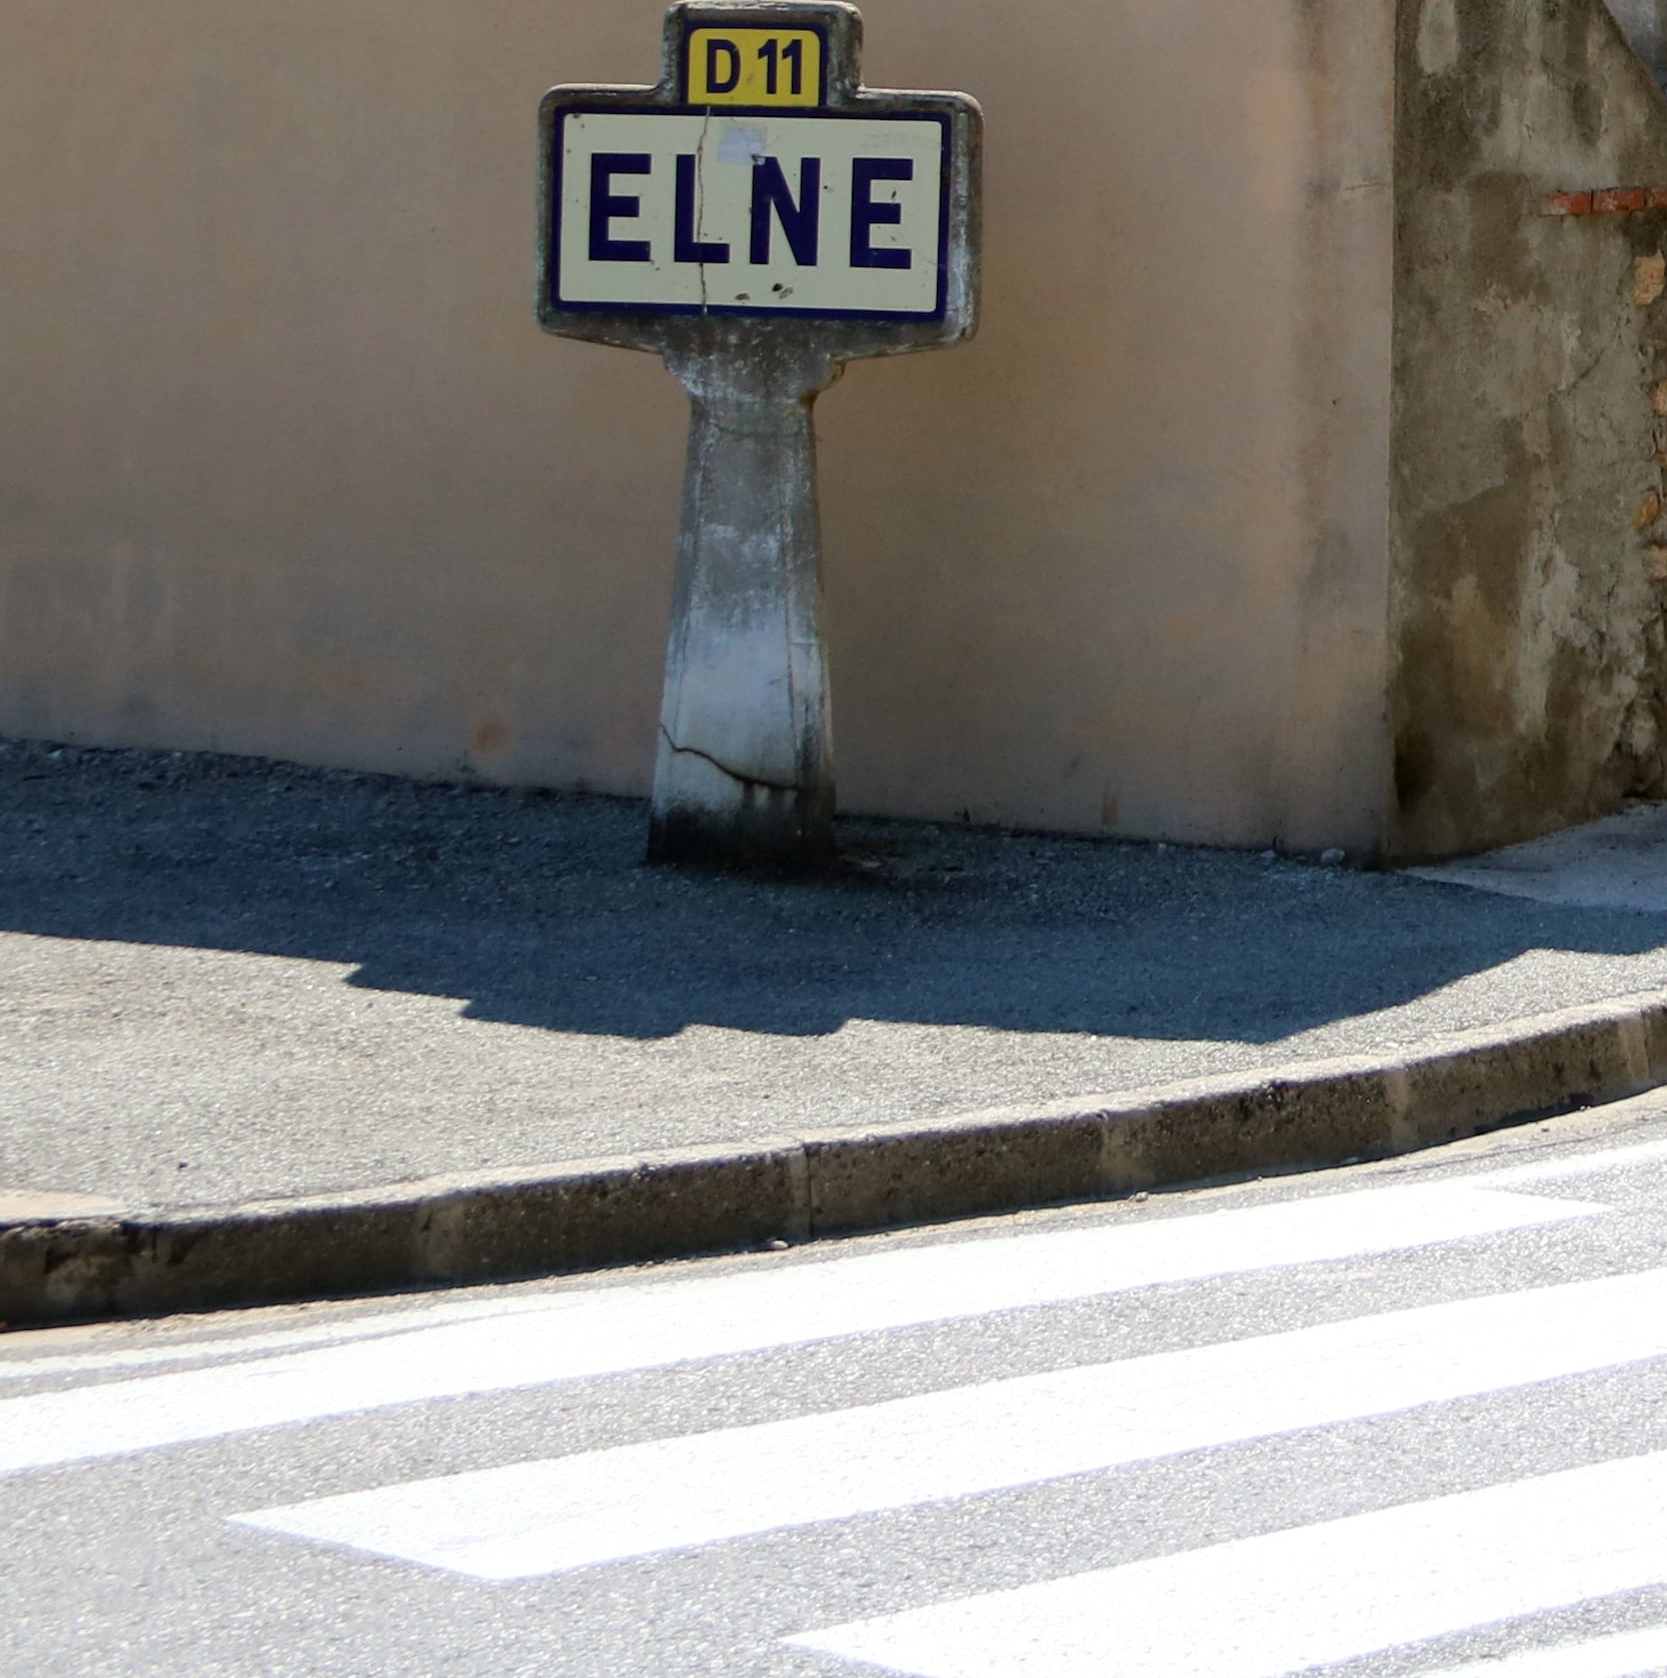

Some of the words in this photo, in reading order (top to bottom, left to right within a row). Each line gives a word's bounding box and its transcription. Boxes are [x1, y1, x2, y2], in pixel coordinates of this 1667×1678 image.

[706, 38, 741, 94] D
[757, 38, 803, 95] 11
[588, 152, 914, 270] ELNE
